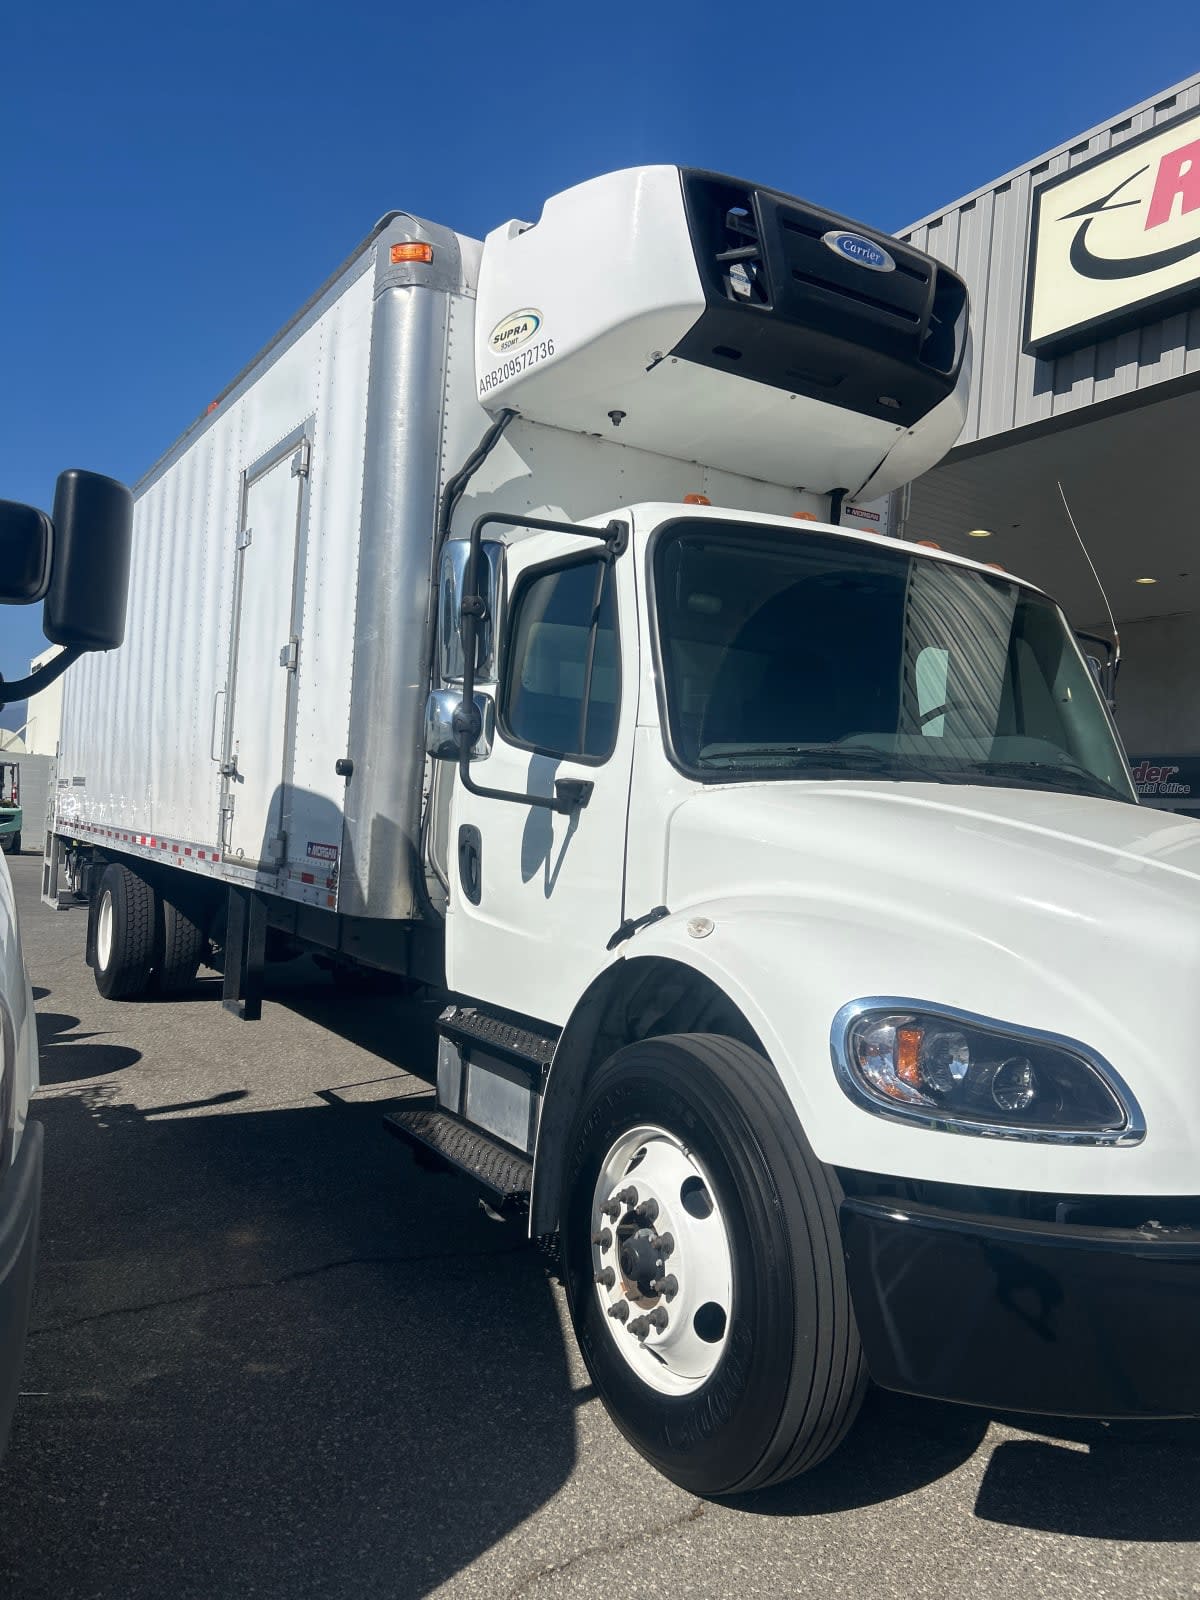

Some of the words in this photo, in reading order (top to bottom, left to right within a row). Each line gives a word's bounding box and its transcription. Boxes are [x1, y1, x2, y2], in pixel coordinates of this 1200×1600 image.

[843, 240, 880, 262] Carrier
[493, 322, 528, 344] SUPRA
[479, 338, 555, 396] ARB209572736
[1130, 761, 1174, 784] der
[1136, 783, 1158, 794] ntal
[1159, 782, 1191, 794] Office
